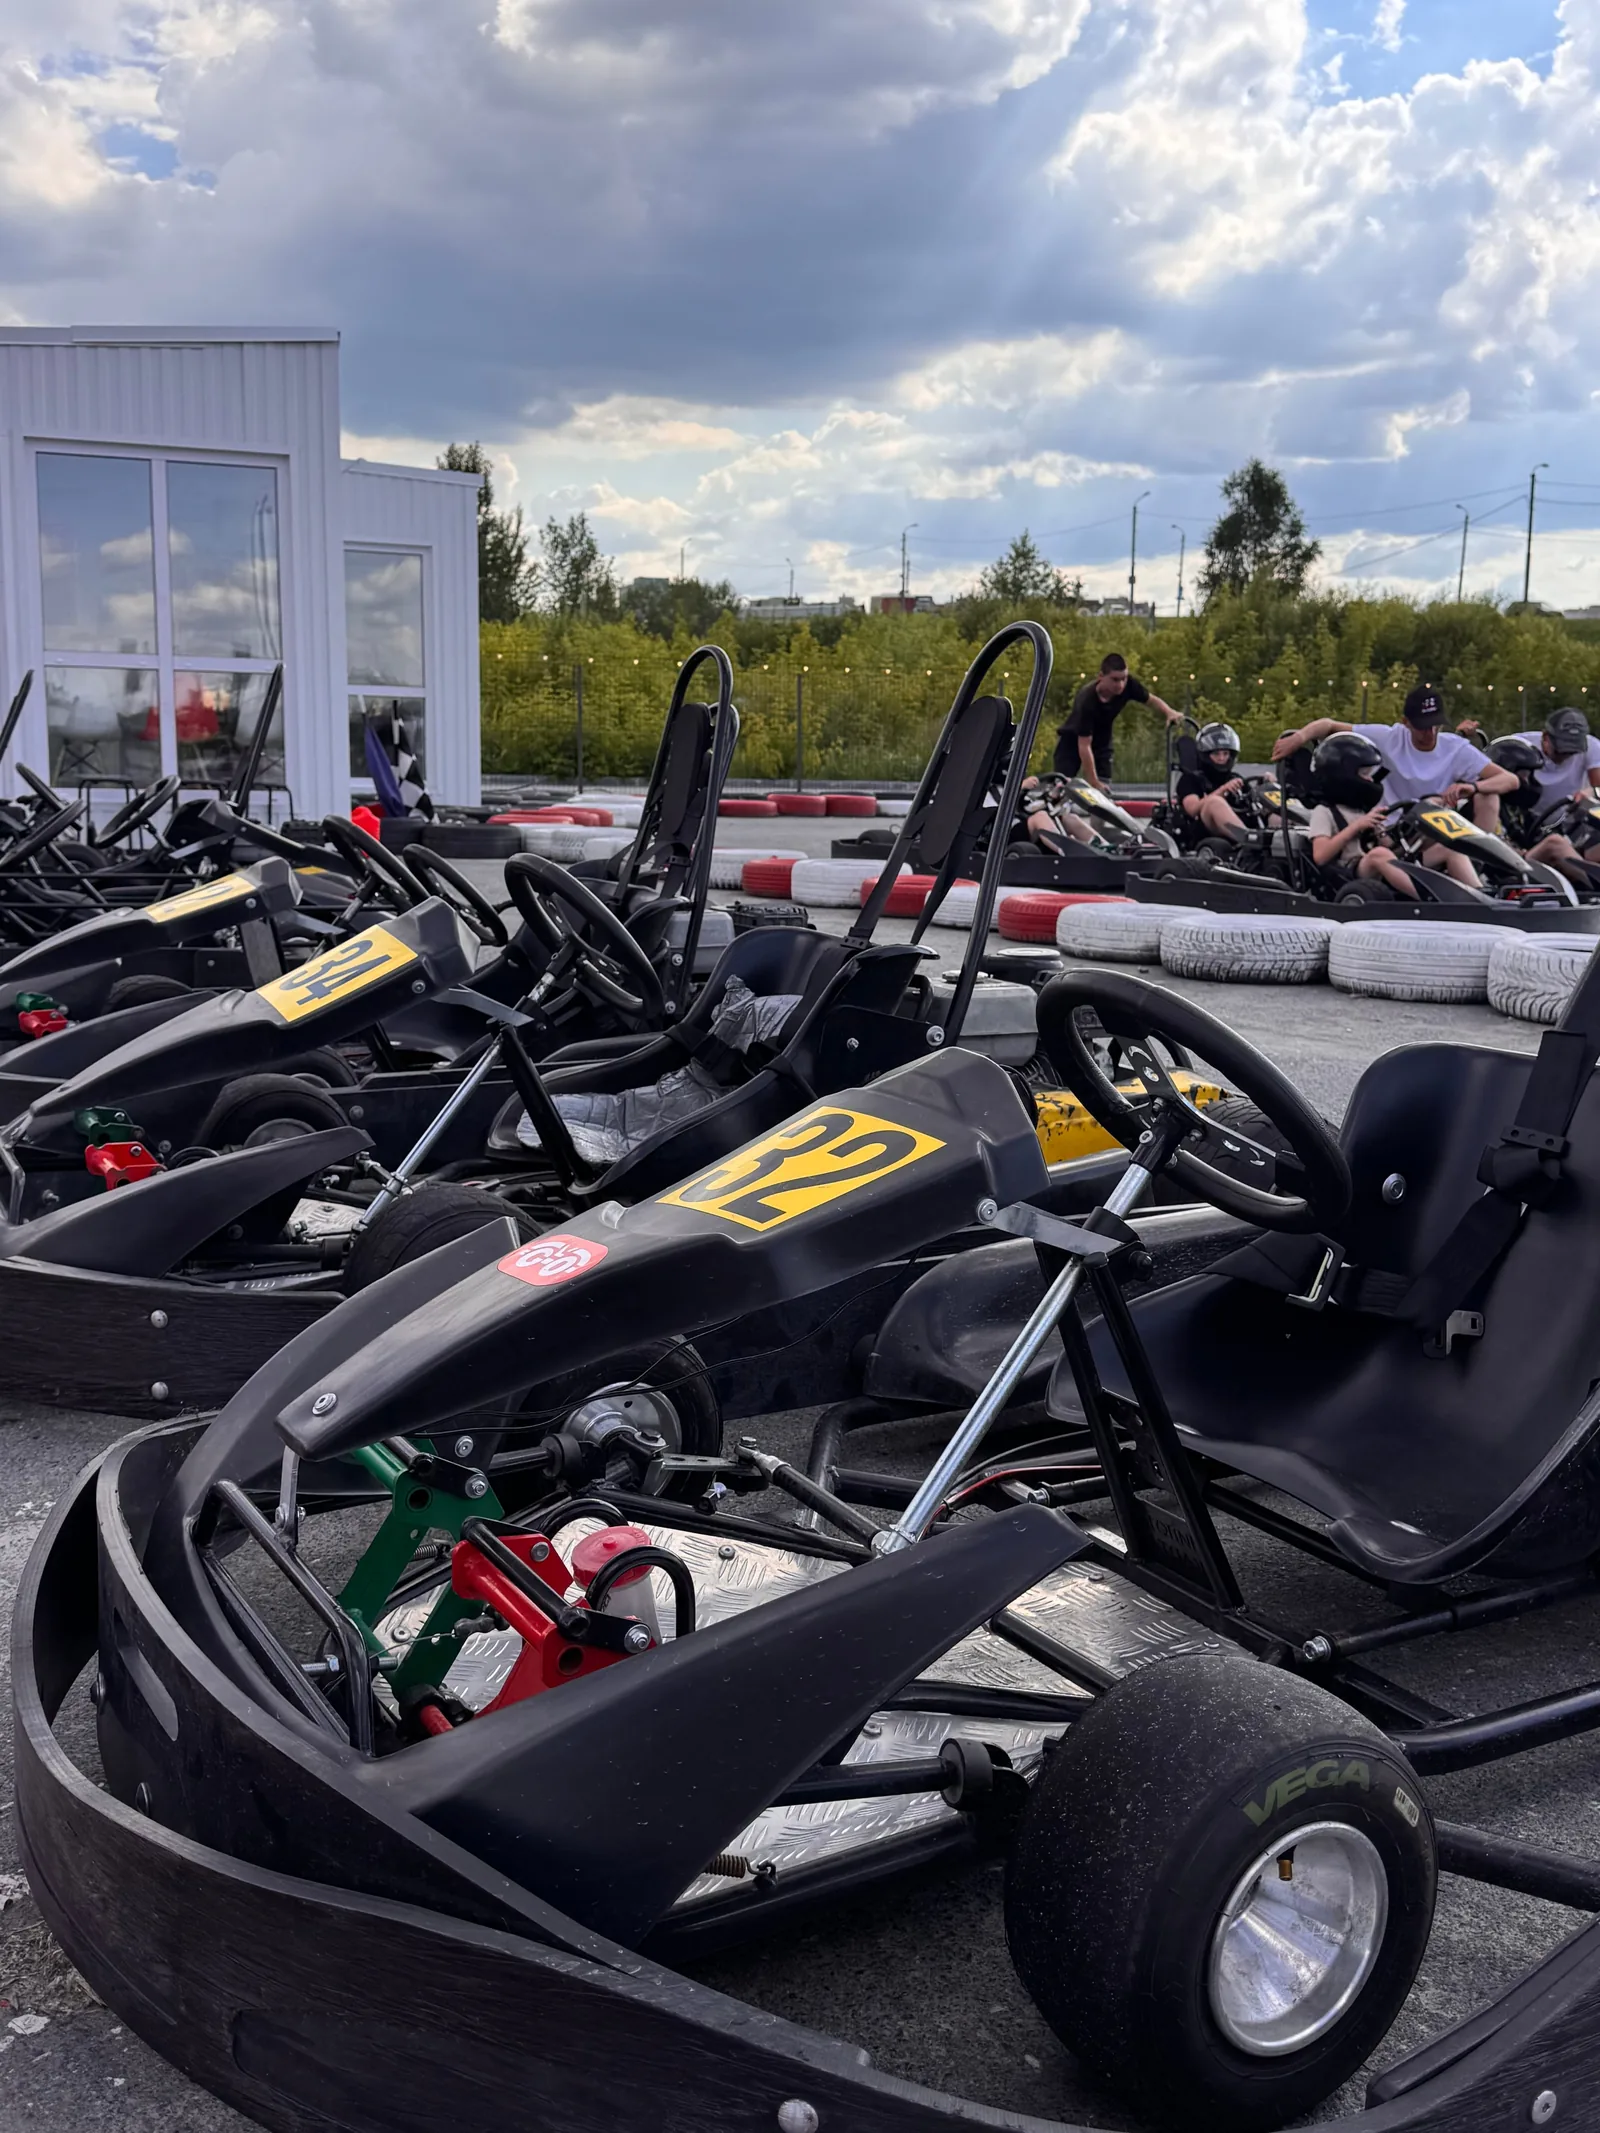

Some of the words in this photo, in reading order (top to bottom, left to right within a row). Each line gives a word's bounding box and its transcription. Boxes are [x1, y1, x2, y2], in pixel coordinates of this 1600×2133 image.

[279, 940, 392, 1005] 34
[679, 1113, 917, 1225] 32
[1242, 1759, 1370, 1827] VEGA
